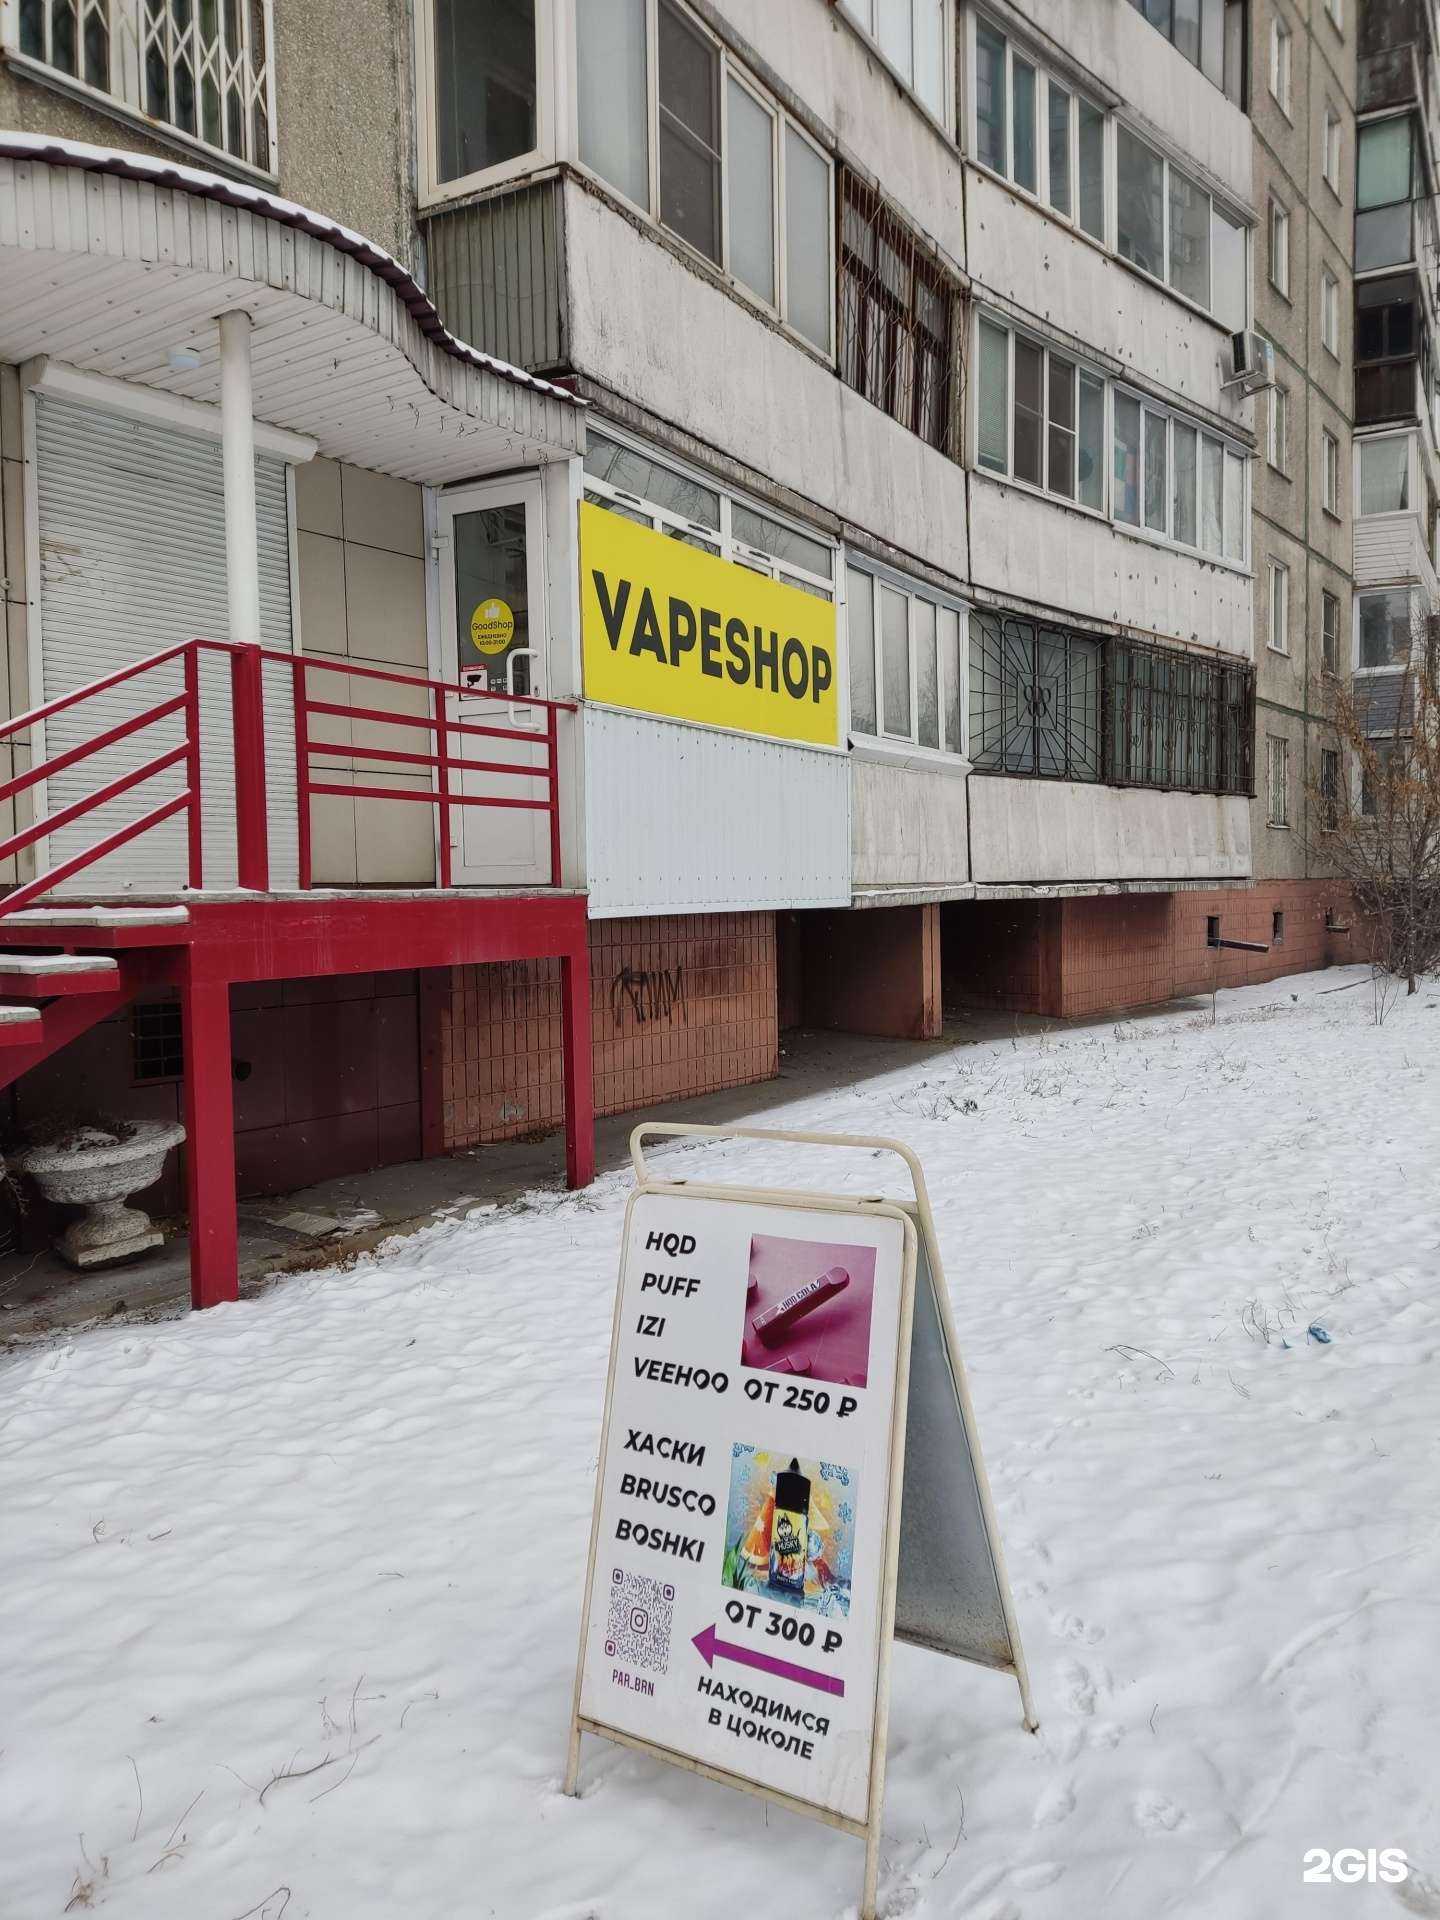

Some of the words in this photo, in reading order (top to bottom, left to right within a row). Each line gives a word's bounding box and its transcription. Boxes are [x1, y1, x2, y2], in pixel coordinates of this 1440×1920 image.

[472, 621, 512, 631] GoodShop
[592, 569, 832, 704] VAPESHOP
[645, 1231, 696, 1257] HQD
[640, 1272, 701, 1298] PUFF
[636, 1314, 666, 1337] IZI
[634, 1357, 729, 1394] VEEHOO
[744, 1378, 779, 1404] ОТ
[783, 1386, 830, 1414] 250
[623, 1429, 706, 1467] ХАСКИ
[619, 1473, 717, 1517] BRUSCO
[615, 1518, 705, 1563] BOSHKI
[725, 1600, 761, 1628] ОТ
[765, 1612, 815, 1647] 300
[612, 1669, 655, 1696] PAR_BRN
[697, 1676, 830, 1736] НАХОДИМСЯ
[708, 1708, 722, 1726] В
[726, 1716, 815, 1760] ЦОКОЛЕ
